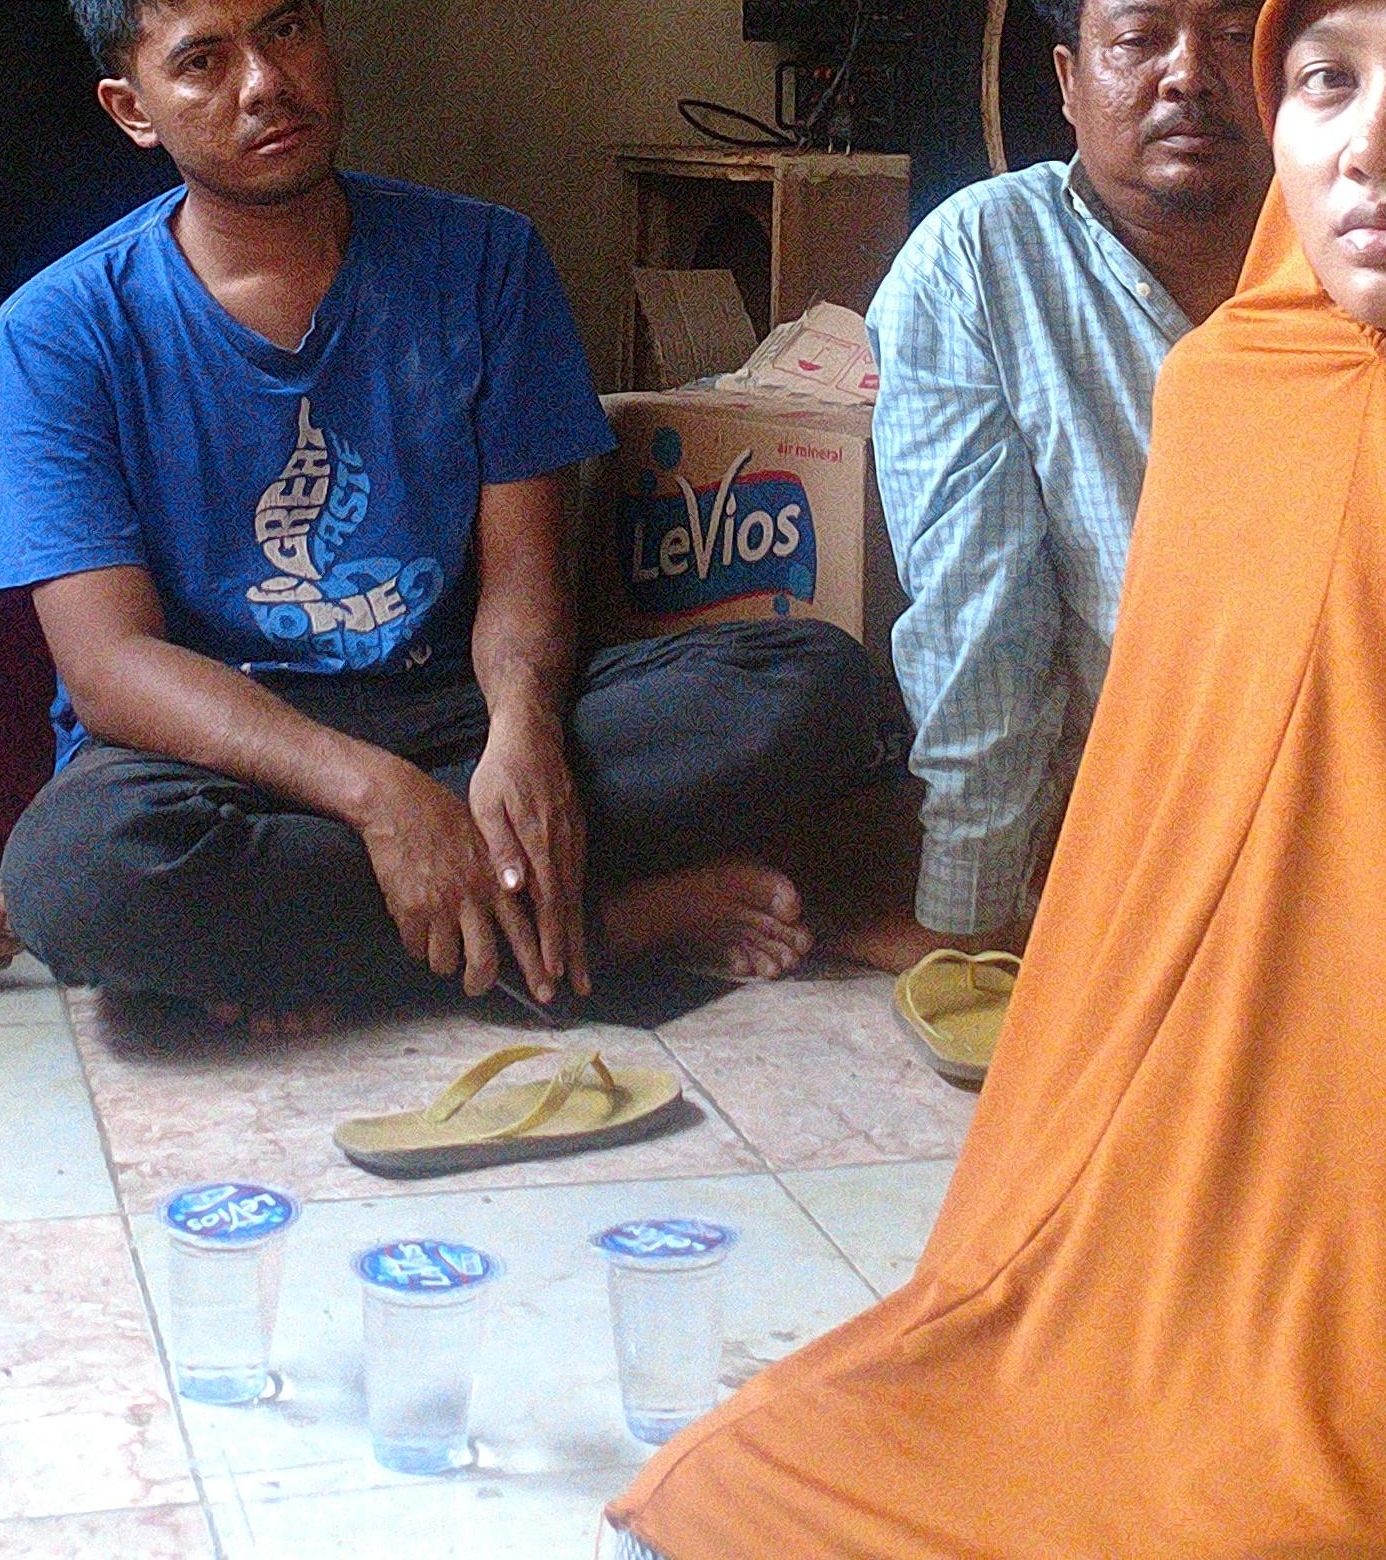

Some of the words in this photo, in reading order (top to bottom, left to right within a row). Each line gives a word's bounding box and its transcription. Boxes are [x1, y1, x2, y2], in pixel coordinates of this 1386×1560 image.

[255, 397, 331, 580] GREAT
[314, 426, 370, 575] TASTE
[631, 450, 801, 579] LeVios
[777, 442, 793, 456] air
[795, 443, 842, 461] mineral
